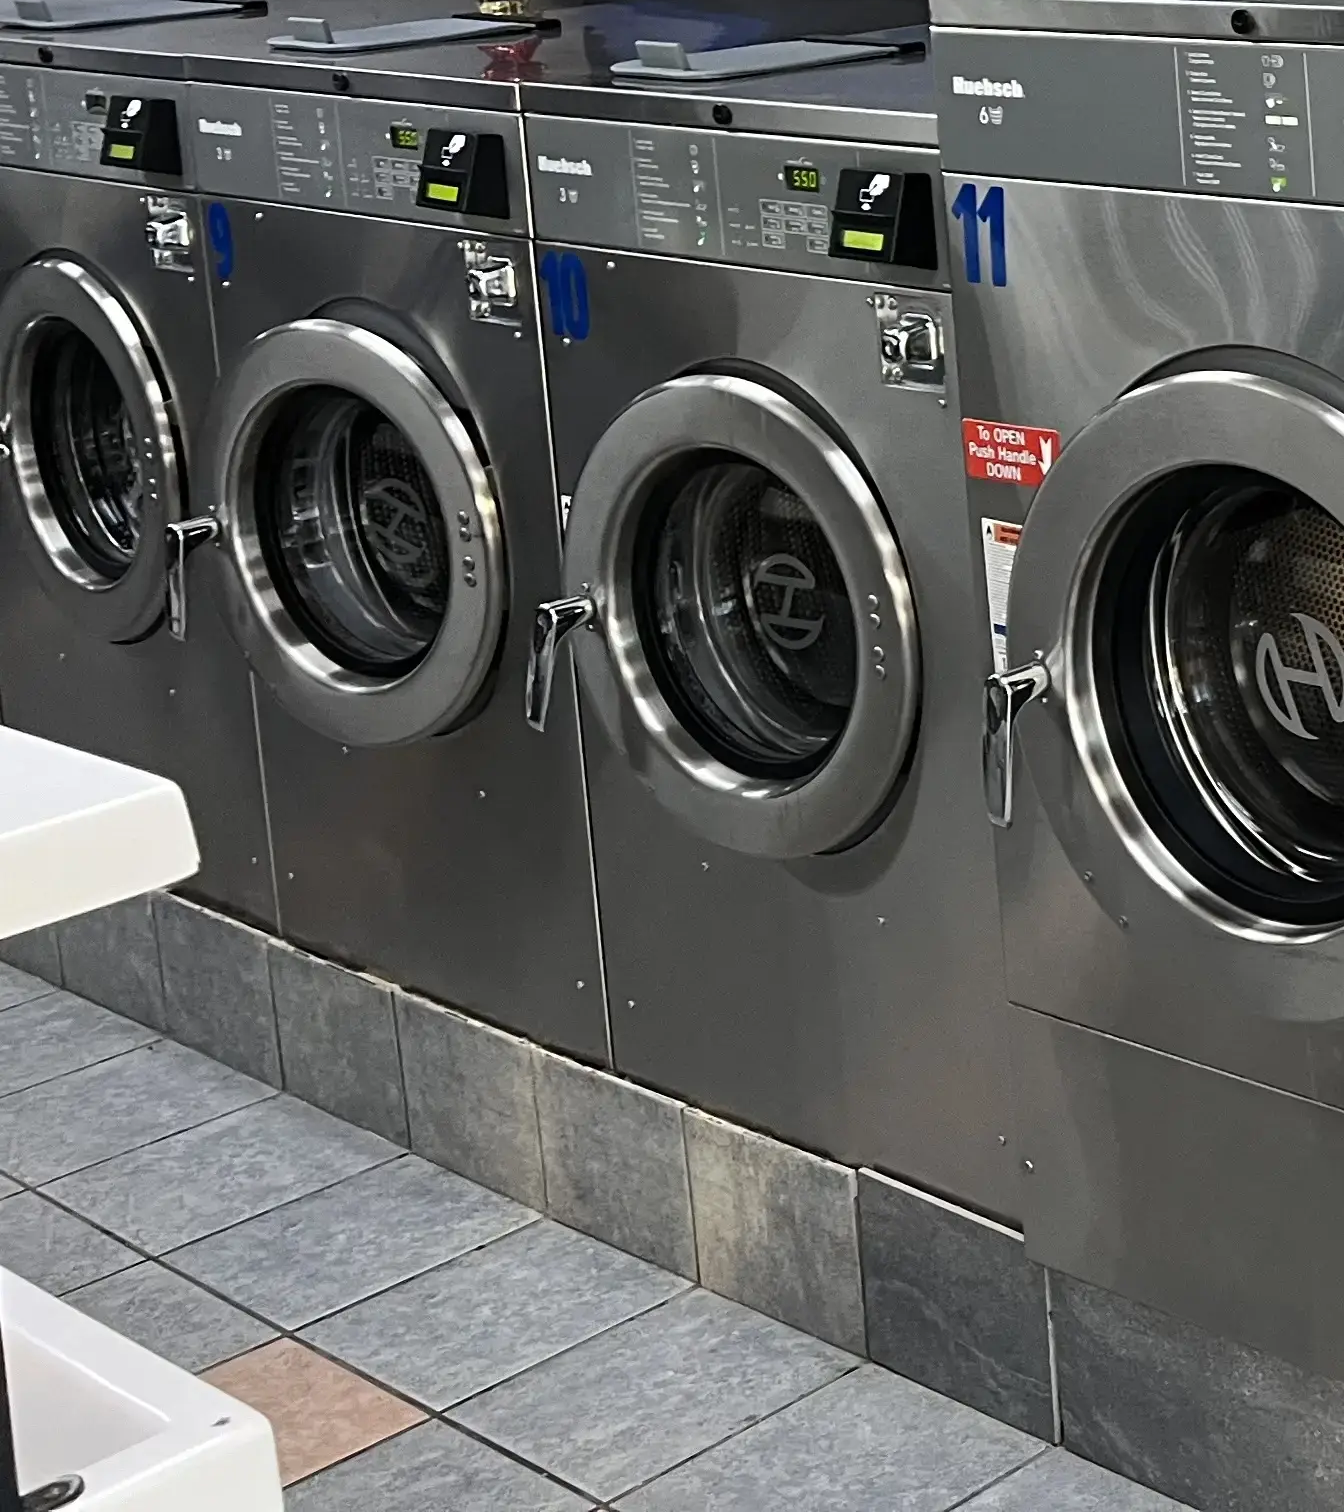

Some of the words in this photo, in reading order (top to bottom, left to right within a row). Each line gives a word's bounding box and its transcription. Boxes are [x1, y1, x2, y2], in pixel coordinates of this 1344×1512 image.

[950, 182, 1008, 288] 11
[539, 249, 592, 342] 10
[975, 424, 991, 442] To
[993, 426, 1026, 448] OPEN
[968, 441, 995, 460] Push
[997, 447, 1038, 468] Handle
[985, 460, 1022, 483] DOWN
